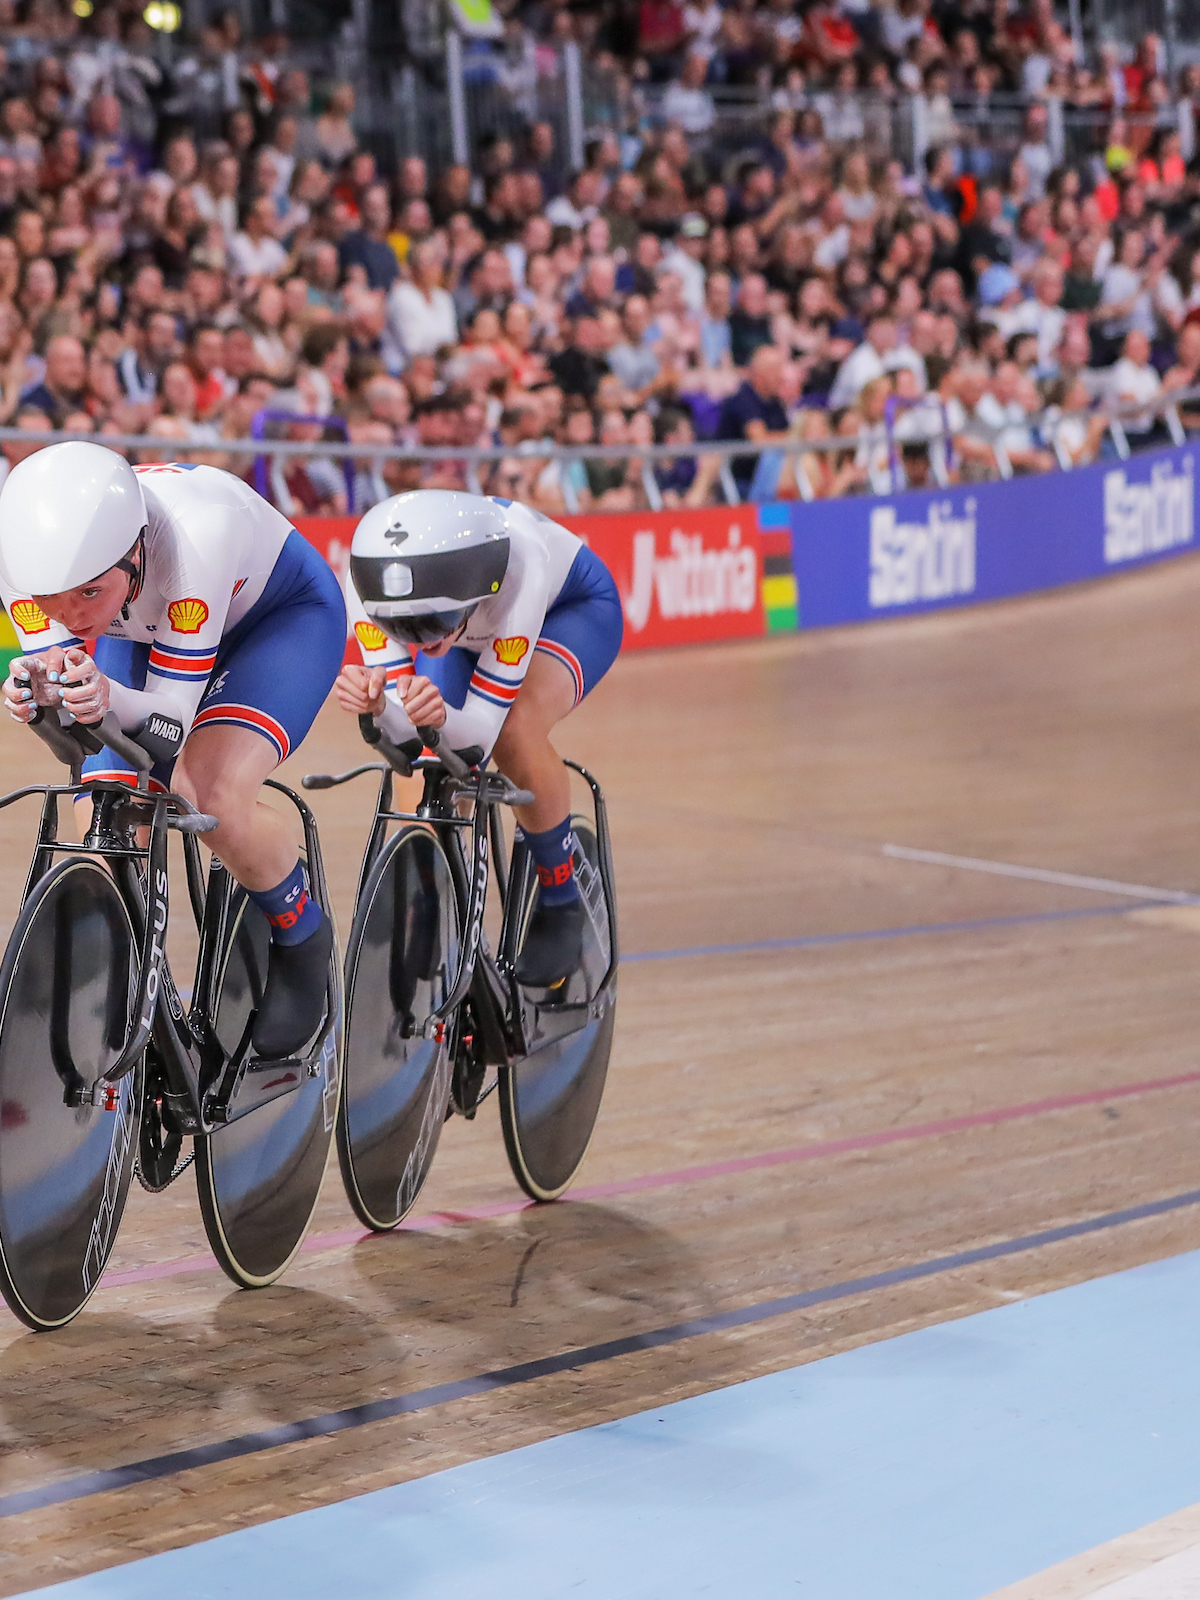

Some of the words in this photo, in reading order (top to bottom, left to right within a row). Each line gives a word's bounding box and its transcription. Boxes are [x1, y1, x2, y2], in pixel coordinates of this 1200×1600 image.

[869, 495, 977, 609] Santini
[1103, 453, 1195, 564] Santini
[149, 717, 182, 742] WARD
[466, 834, 488, 974] LOTUS
[536, 853, 574, 887] GB
[140, 868, 168, 1031] LOTUS
